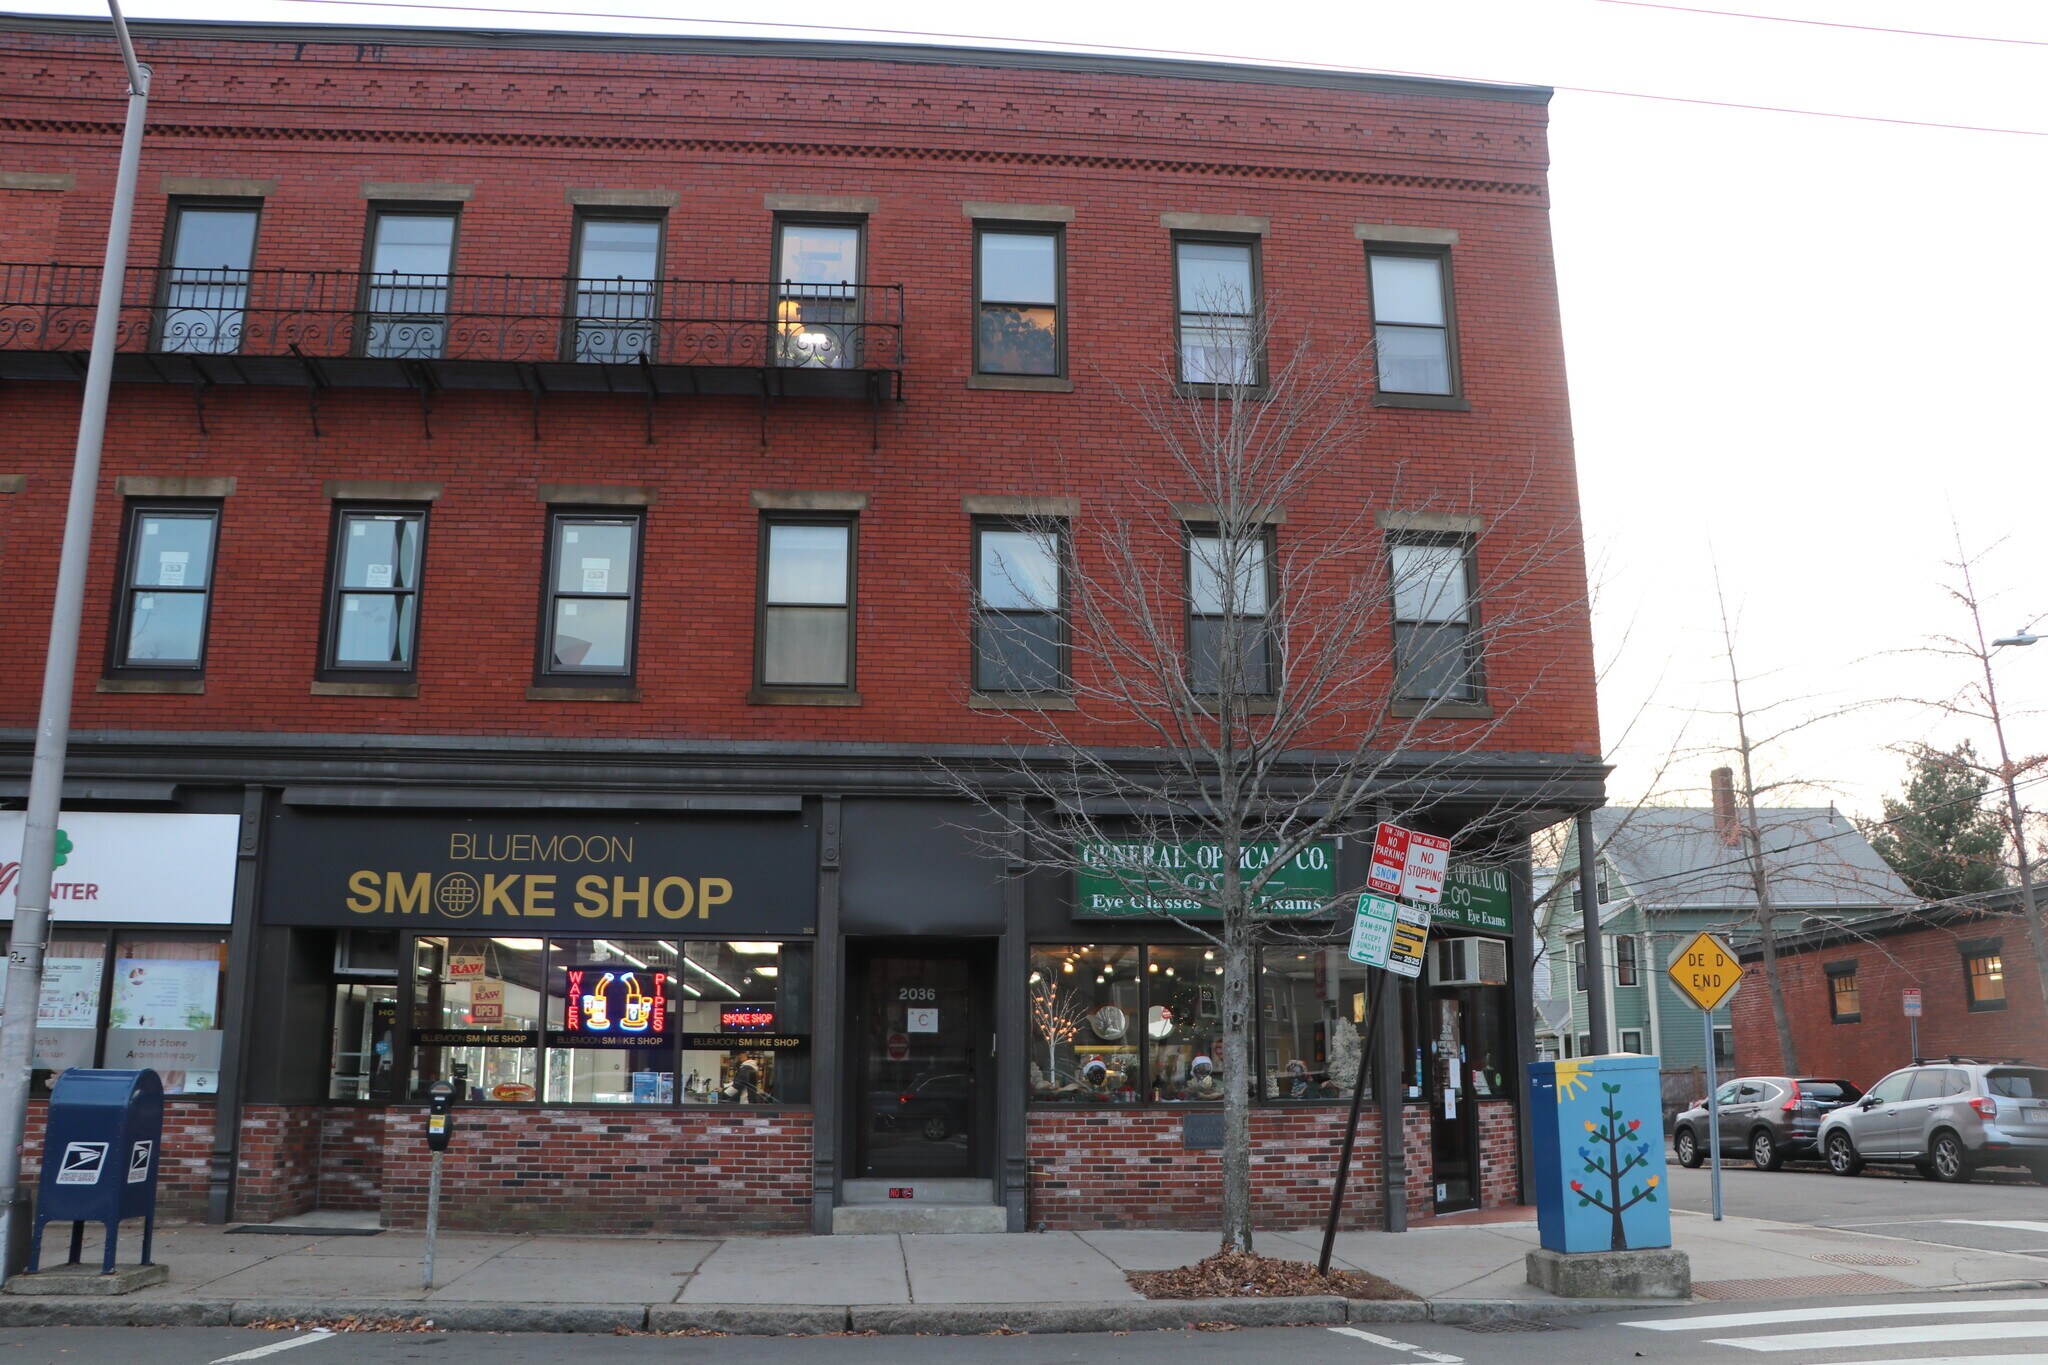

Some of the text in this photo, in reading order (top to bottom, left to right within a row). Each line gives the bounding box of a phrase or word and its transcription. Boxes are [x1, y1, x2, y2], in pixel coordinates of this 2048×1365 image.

[1394, 829, 1405, 838] ZONE
[1387, 836, 1398, 847] NO
[1413, 835, 1422, 844] TOW
[1436, 841, 1449, 850] ZONE
[449, 833, 634, 863] BLUEMOON
[1376, 845, 1405, 861] PARKING
[1083, 844, 1328, 870] GENERAL OPICA CO.
[1420, 851, 1434, 865] NO
[1376, 866, 1398, 880] SNOW
[1407, 864, 1442, 882] STOPPING
[1455, 863, 1491, 889] OPTICAL
[1493, 870, 1508, 893] CO.
[573, 875, 733, 919] SHOP
[1092, 893, 1124, 911] Eye
[1361, 898, 1369, 913] 2
[1376, 902, 1386, 910] HR
[1369, 909, 1391, 919] PARKING
[1467, 908, 1506, 927] Eye Exams
[1360, 932, 1381, 943] EXCEPT
[1356, 941, 1382, 952] SUNDAYS
[1391, 953, 1421, 966] Zone 2525
[1688, 953, 1724, 967] DED
[450, 963, 484, 974] RAW
[1693, 974, 1721, 988] END
[475, 990, 500, 1001] RAW
[899, 988, 936, 1000] 2036
[567, 970, 583, 1031] WATER
[652, 973, 666, 1032] PIPES
[475, 1005, 499, 1017] OPEN
[723, 1013, 773, 1024] SMOKE SHOP
[138, 1038, 188, 1047] Hot Stone
[421, 1034, 527, 1043] BLUEMOON SMKE SHOP
[557, 1036, 663, 1045] BLUEMOON SMKE SHOP
[693, 1038, 738, 1046] BLUEMOON
[738, 1038, 771, 1046] SMKE
[126, 1050, 198, 1061] Aromatherapy
[890, 1189, 900, 1198] NO
